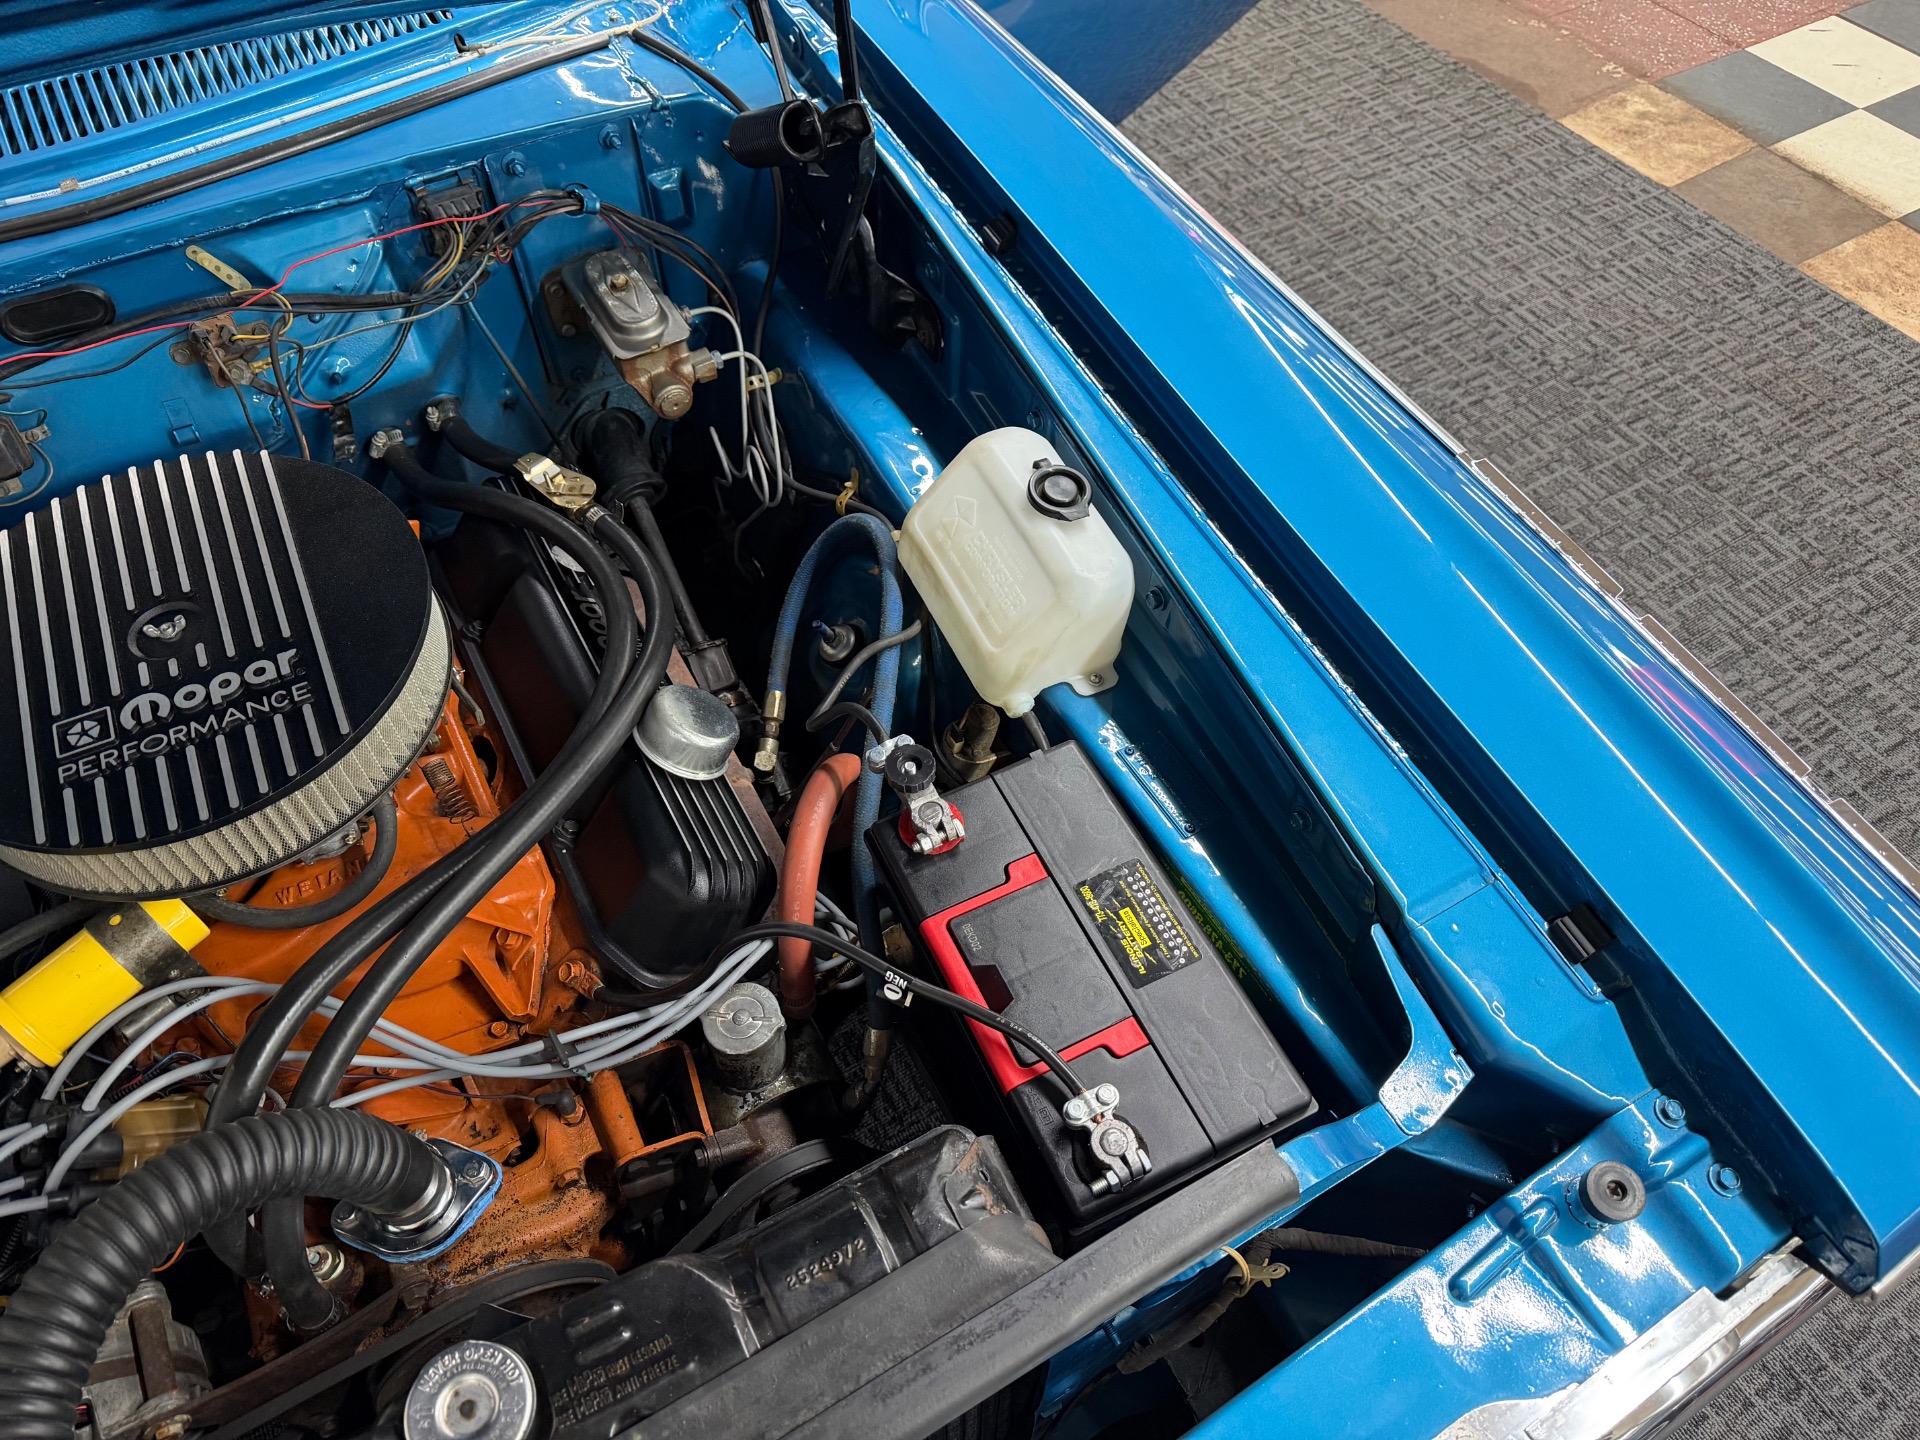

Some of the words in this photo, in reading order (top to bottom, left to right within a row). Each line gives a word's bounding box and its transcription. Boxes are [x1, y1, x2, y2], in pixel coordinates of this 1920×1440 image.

[964, 539, 1017, 617] CORPORATION
[974, 529, 1026, 610] CHRYSLER
[58, 681, 312, 784] PERFORMANCE
[275, 856, 371, 906] WEIAN
[1115, 917, 1145, 959] BATTERY
[1121, 909, 1149, 946] Specialists
[1119, 936, 1147, 975] ILLINOIS
[884, 970, 907, 990] NEG
[1025, 1085, 1043, 1106] SAE
[417, 1350, 461, 1394] NEVER
[464, 1347, 503, 1366] OPEN
[500, 1358, 525, 1386] HOT
